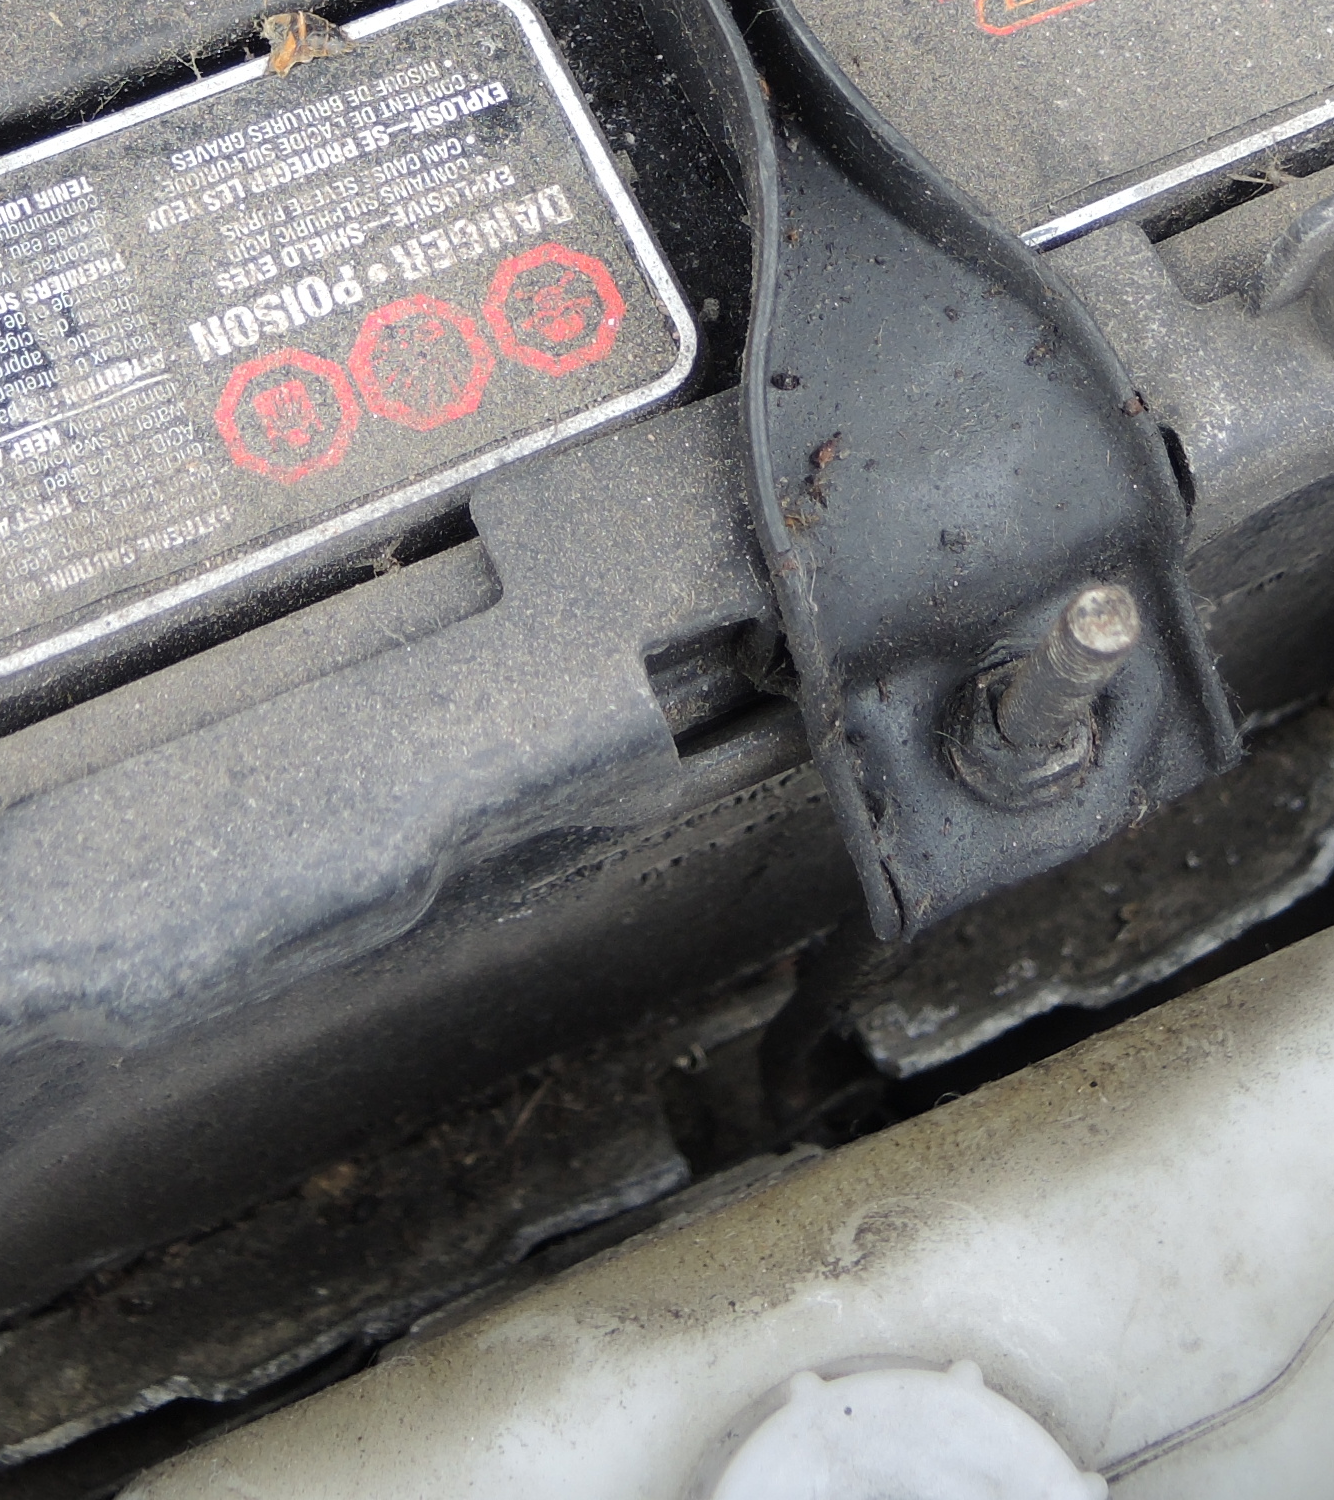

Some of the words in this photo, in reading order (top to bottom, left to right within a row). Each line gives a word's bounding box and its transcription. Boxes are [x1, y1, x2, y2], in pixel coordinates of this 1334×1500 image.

[343, 84, 371, 107] DE
[377, 70, 466, 120] CONTIENT
[349, 105, 376, 128] DE
[170, 128, 244, 172] GRAVES
[421, 135, 463, 165] CAN
[33, 175, 94, 211] TENIR
[379, 155, 470, 205] CONTAINS
[42, 209, 108, 250] grande
[143, 193, 203, 233] YEUX
[274, 190, 379, 245] SULPHURIC
[390, 179, 573, 285] DANGER
[20, 251, 127, 306] PREMIERS
[214, 254, 277, 296] EYES
[2, 311, 28, 334] de
[188, 260, 364, 363] POISON
[5, 426, 61, 463] KEEP
